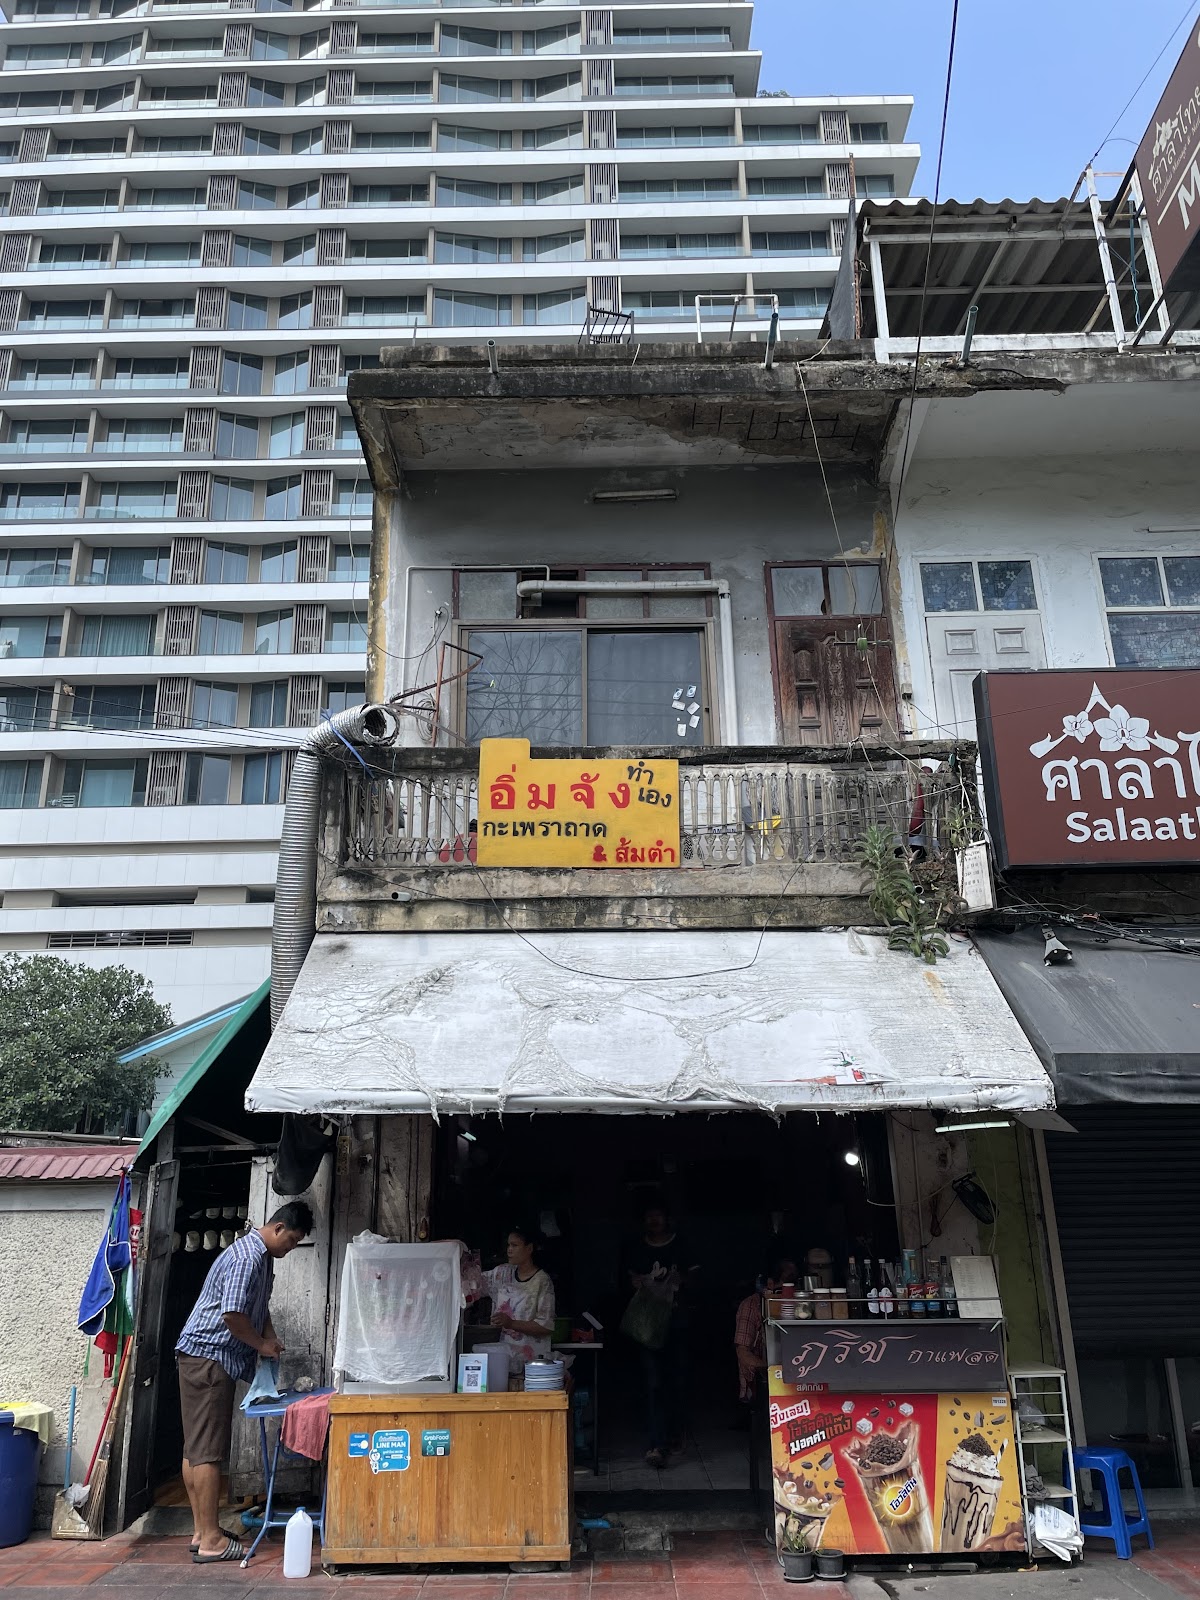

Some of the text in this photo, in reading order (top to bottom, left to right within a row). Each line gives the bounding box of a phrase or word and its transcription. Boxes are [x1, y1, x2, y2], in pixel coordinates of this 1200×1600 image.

[638, 787, 672, 808] เอง
[483, 820, 608, 838] กะเพราถาด
[1066, 807, 1200, 843] Salaat
[593, 837, 676, 863] & ส้มตำ
[908, 1348, 999, 1366] กาแฟสด
